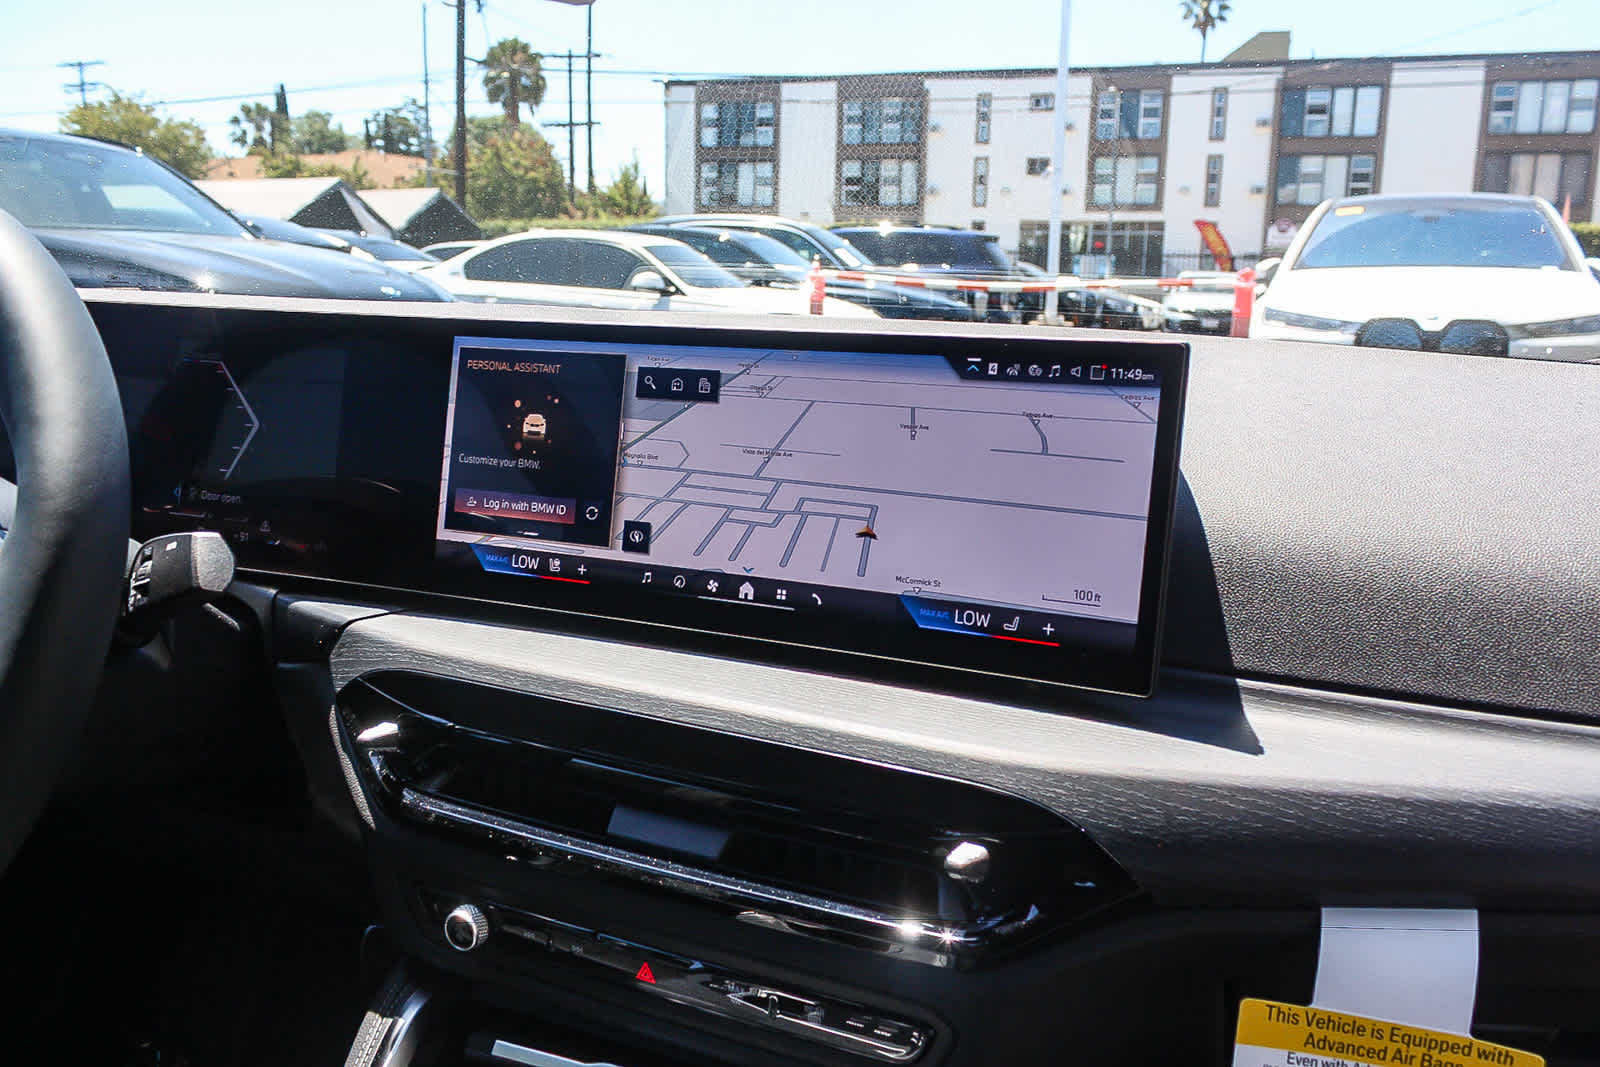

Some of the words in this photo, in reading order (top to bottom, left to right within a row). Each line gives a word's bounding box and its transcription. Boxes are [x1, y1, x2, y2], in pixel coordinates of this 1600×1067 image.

[467, 359, 512, 372] PERSONAL
[513, 362, 561, 374] ASSISTANT
[458, 452, 498, 466] Customize
[500, 458, 517, 468] your
[518, 458, 541, 470] BMW.
[483, 497, 500, 511] Log
[501, 499, 510, 510] in
[511, 500, 529, 512] with
[531, 501, 554, 514] BMW
[556, 504, 567, 515] ID
[511, 553, 540, 570] LOW
[895, 575, 932, 588] McCormick
[933, 579, 942, 588] St
[1073, 589, 1093, 601] 100
[1094, 592, 1102, 602] ft
[954, 608, 991, 629] LOW
[1265, 1003, 1301, 1026] This
[1304, 1010, 1368, 1037] Vehicle
[1370, 1027, 1385, 1041] is
[1388, 1026, 1474, 1057] Equipped
[1476, 1046, 1515, 1067] with
[1303, 1032, 1389, 1062] Advanced
[1391, 1050, 1417, 1067] Air
[1420, 1053, 1465, 1067] Ba
[1286, 1051, 1319, 1067] Even
